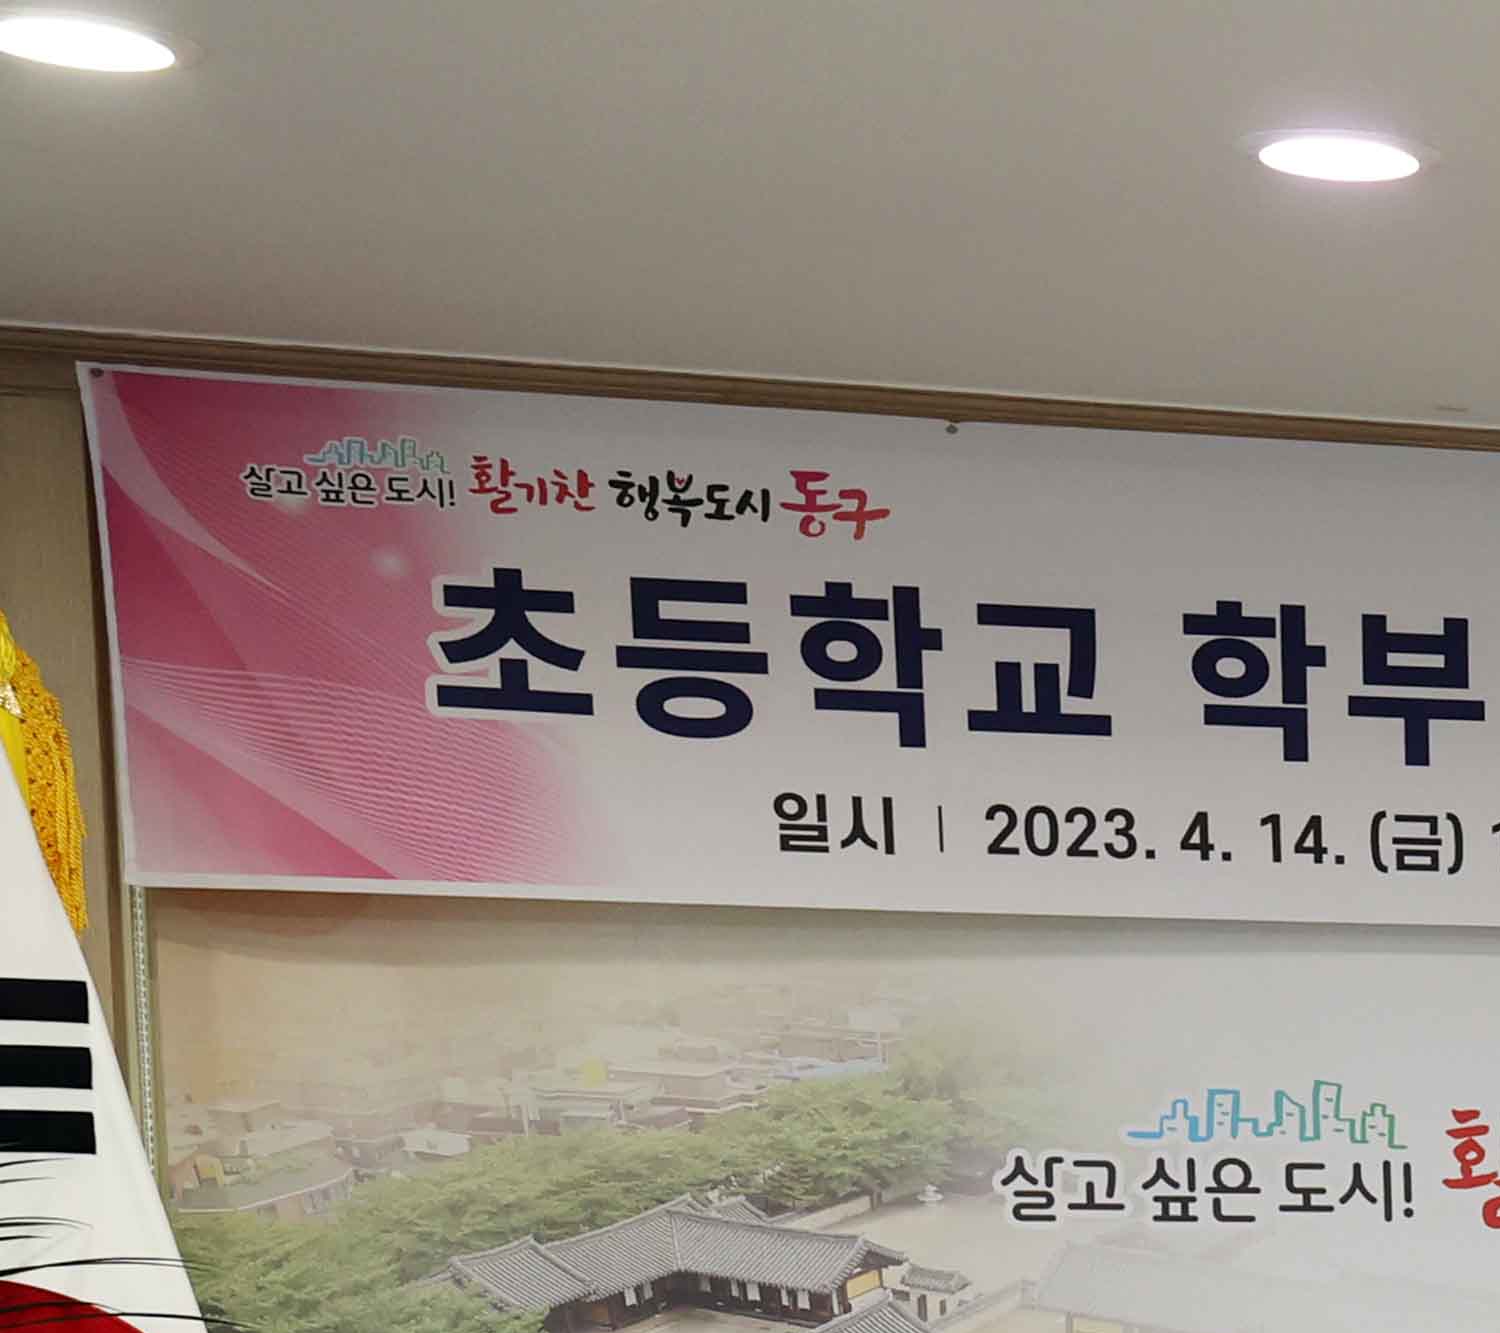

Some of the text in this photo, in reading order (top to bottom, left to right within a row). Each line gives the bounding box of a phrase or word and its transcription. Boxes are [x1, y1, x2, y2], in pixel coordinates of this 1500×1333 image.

[243, 453, 892, 539] 살고 싶은 도시! 활기찬 행복도시 동구
[434, 566, 1114, 748] 초등학교
[771, 792, 898, 858] 일시
[984, 802, 1157, 863] 2023.
[1180, 812, 1232, 866] 4.
[1260, 812, 1346, 869] 14.
[1367, 813, 1464, 876] (금)
[1000, 1153, 1124, 1219] 살고
[1142, 1159, 1261, 1224] 싶은
[1280, 1157, 1414, 1224] 도시!
